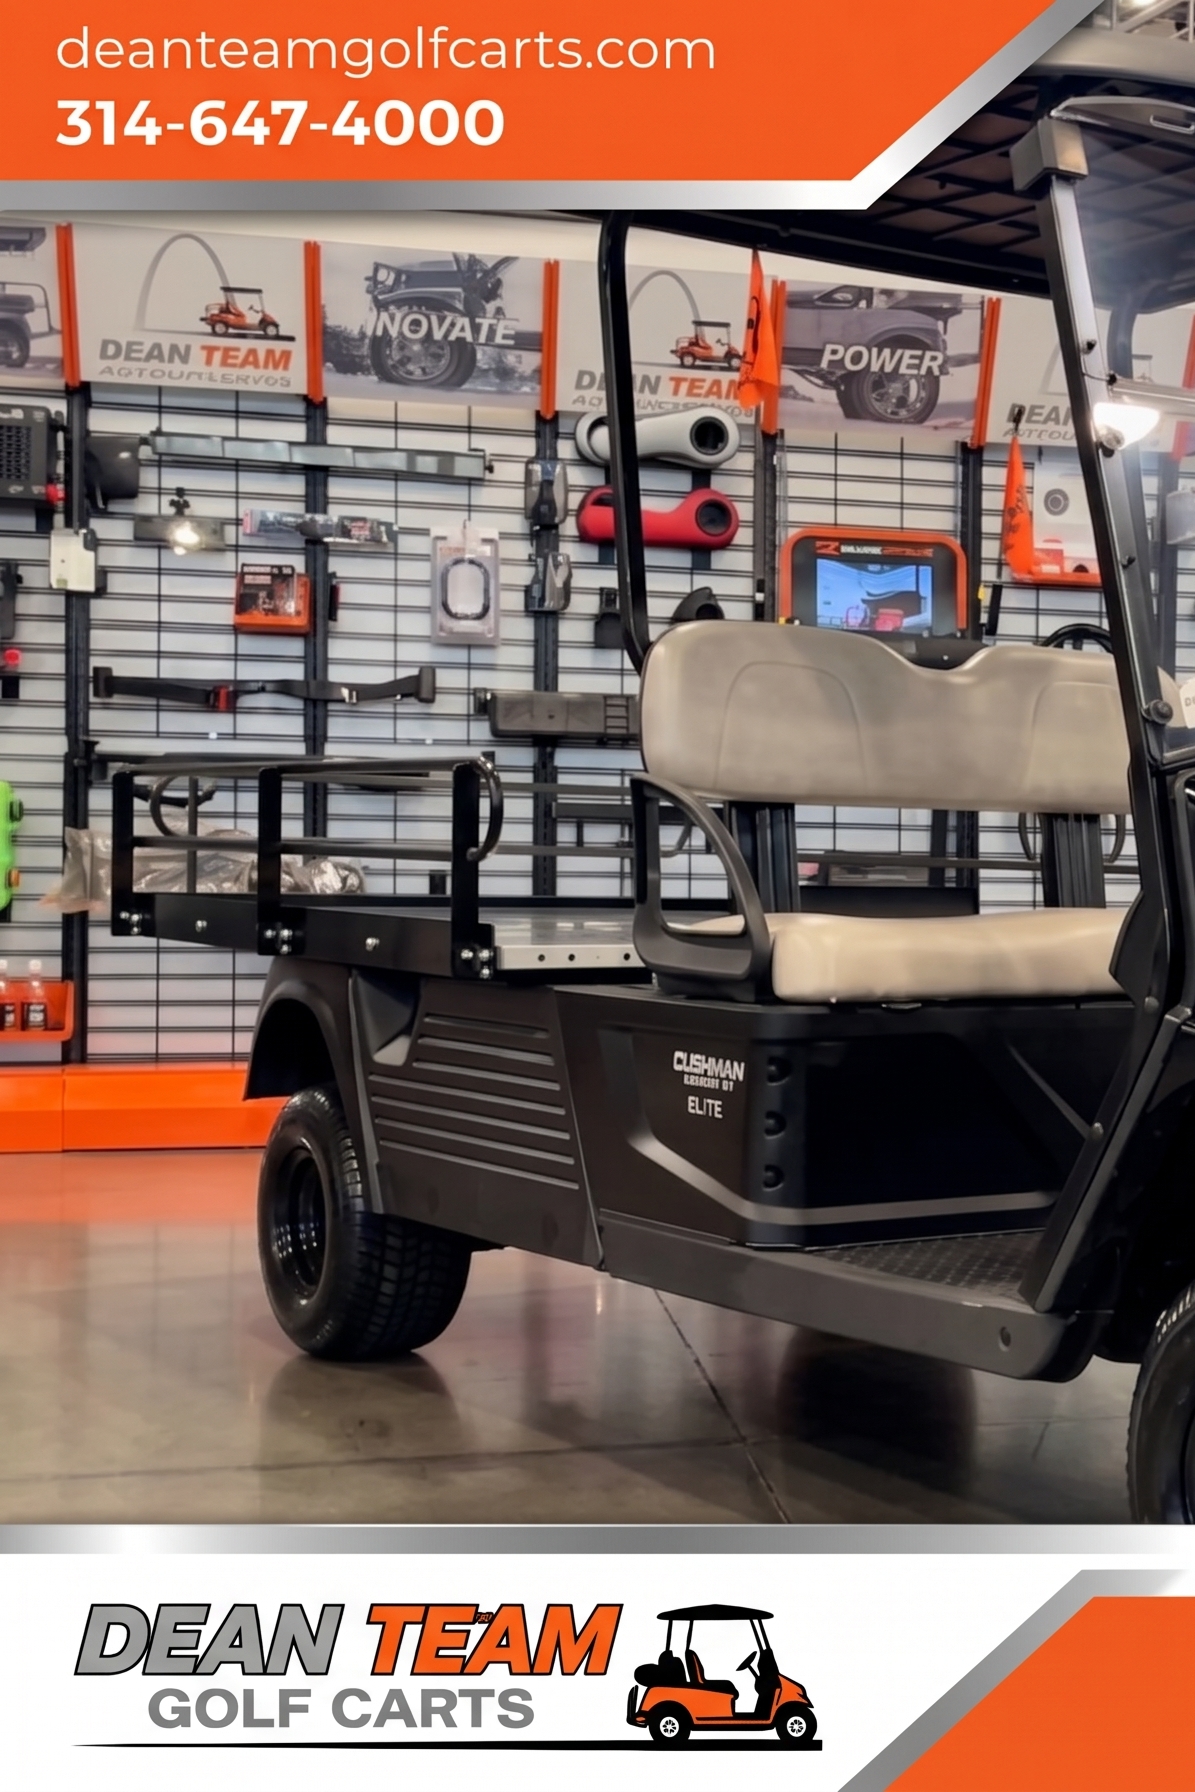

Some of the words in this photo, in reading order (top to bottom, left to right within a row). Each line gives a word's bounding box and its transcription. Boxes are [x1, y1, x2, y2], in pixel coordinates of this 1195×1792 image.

[98, 338, 192, 366] DEAN
[200, 344, 293, 372] TEAM
[819, 343, 945, 377] POWER
[574, 369, 661, 395] DN
[672, 1050, 746, 1083] CUSHMAN
[686, 1095, 724, 1119] ELITE
